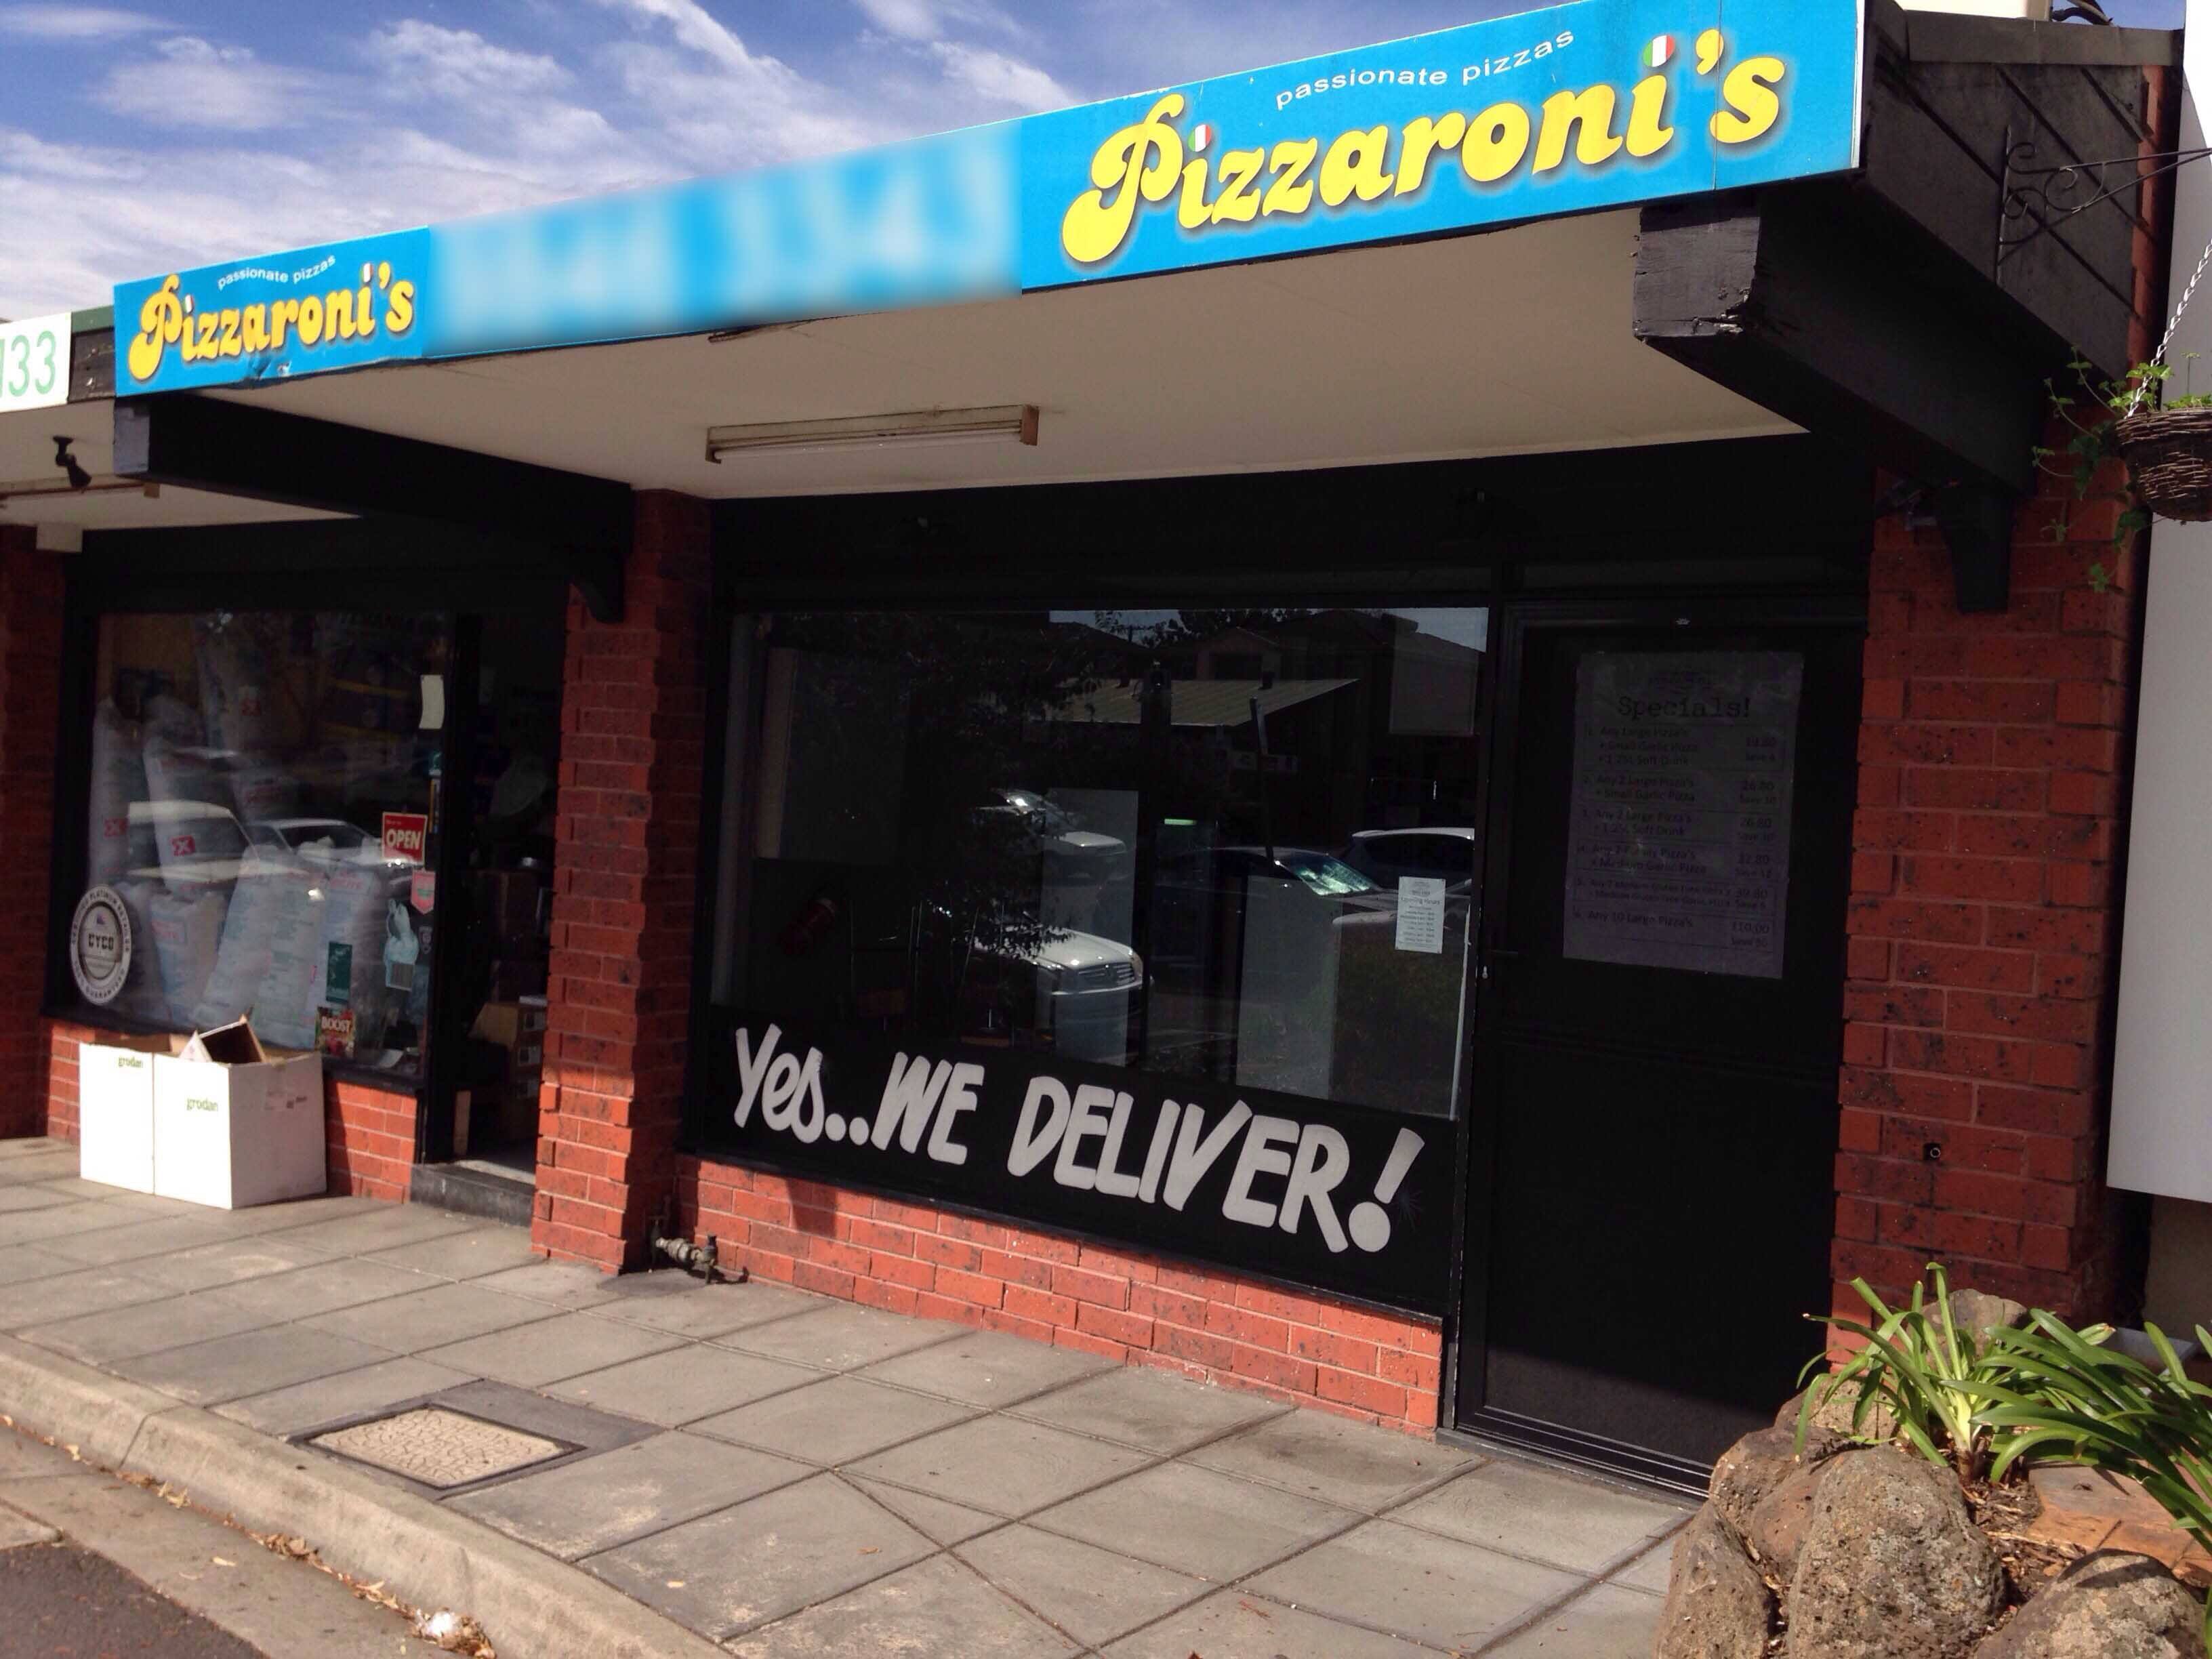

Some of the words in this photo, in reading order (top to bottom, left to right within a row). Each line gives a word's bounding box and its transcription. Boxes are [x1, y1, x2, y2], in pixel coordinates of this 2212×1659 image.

[1275, 64, 1449, 111] passionate
[1461, 28, 1575, 86] pizzas
[1062, 28, 1786, 263] Pizzaroni's
[218, 268, 289, 291] passionate
[293, 254, 336, 284] pizzas
[128, 261, 415, 380] Pizzaroni's
[1617, 695, 1751, 722] Specials!
[386, 828, 422, 851] OPEN
[88, 933, 115, 951] CYCO
[321, 1016, 351, 1033] BOOST
[118, 1056, 144, 1069] grodan
[186, 1097, 219, 1112] grodan
[870, 1050, 985, 1165] WE
